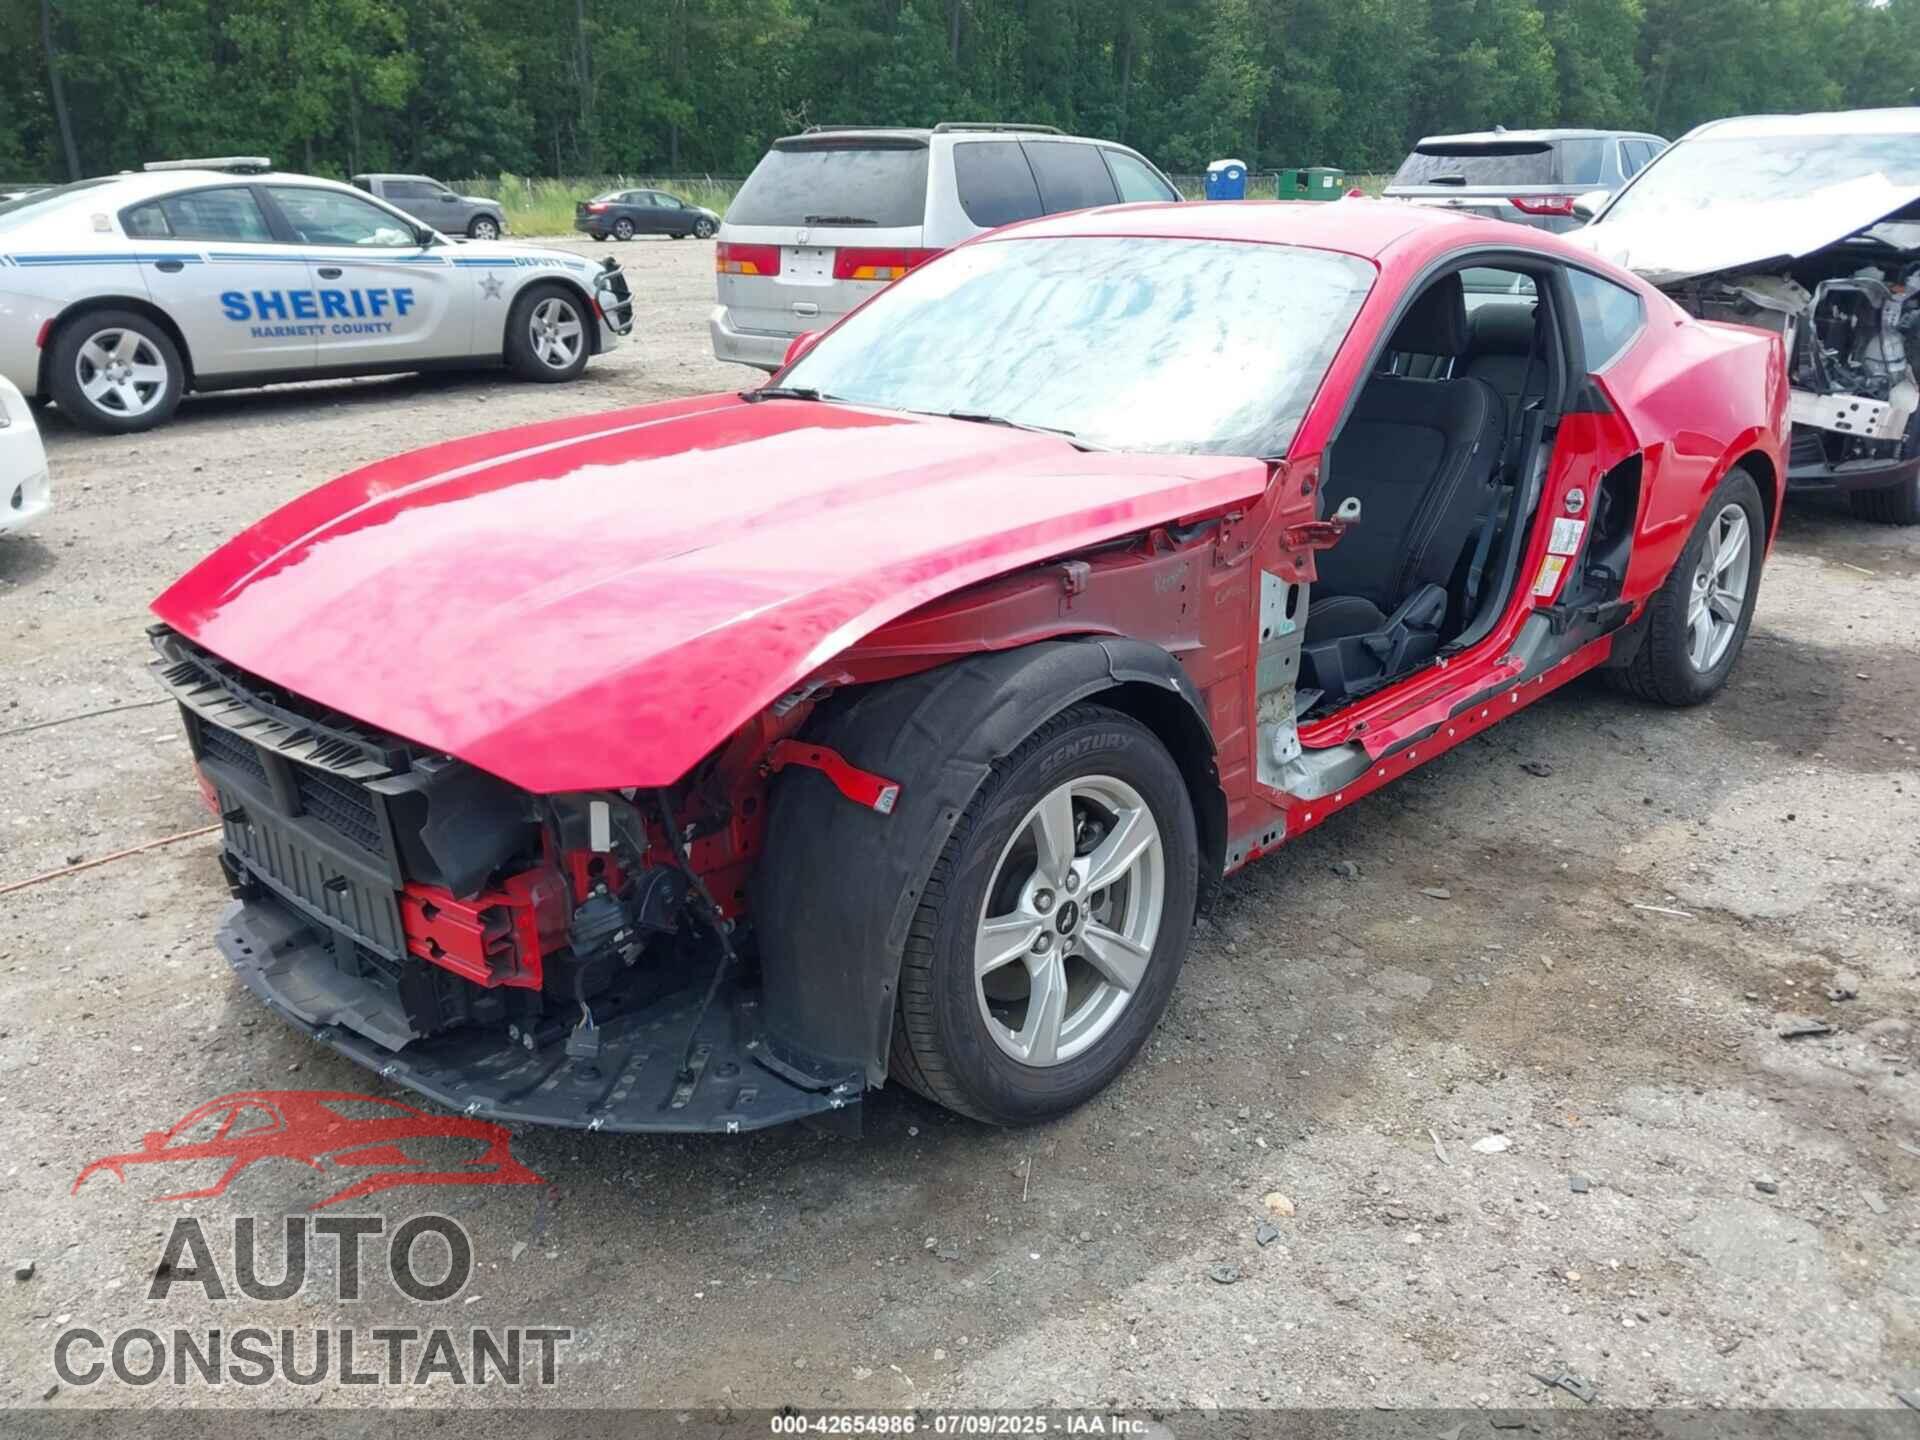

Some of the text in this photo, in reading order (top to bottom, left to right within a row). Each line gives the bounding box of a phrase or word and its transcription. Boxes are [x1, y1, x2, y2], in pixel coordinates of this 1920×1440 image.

[516, 255, 562, 268] DEPUTY
[220, 287, 416, 321] SHERIFF
[251, 322, 392, 338] HARNETT COUNTY
